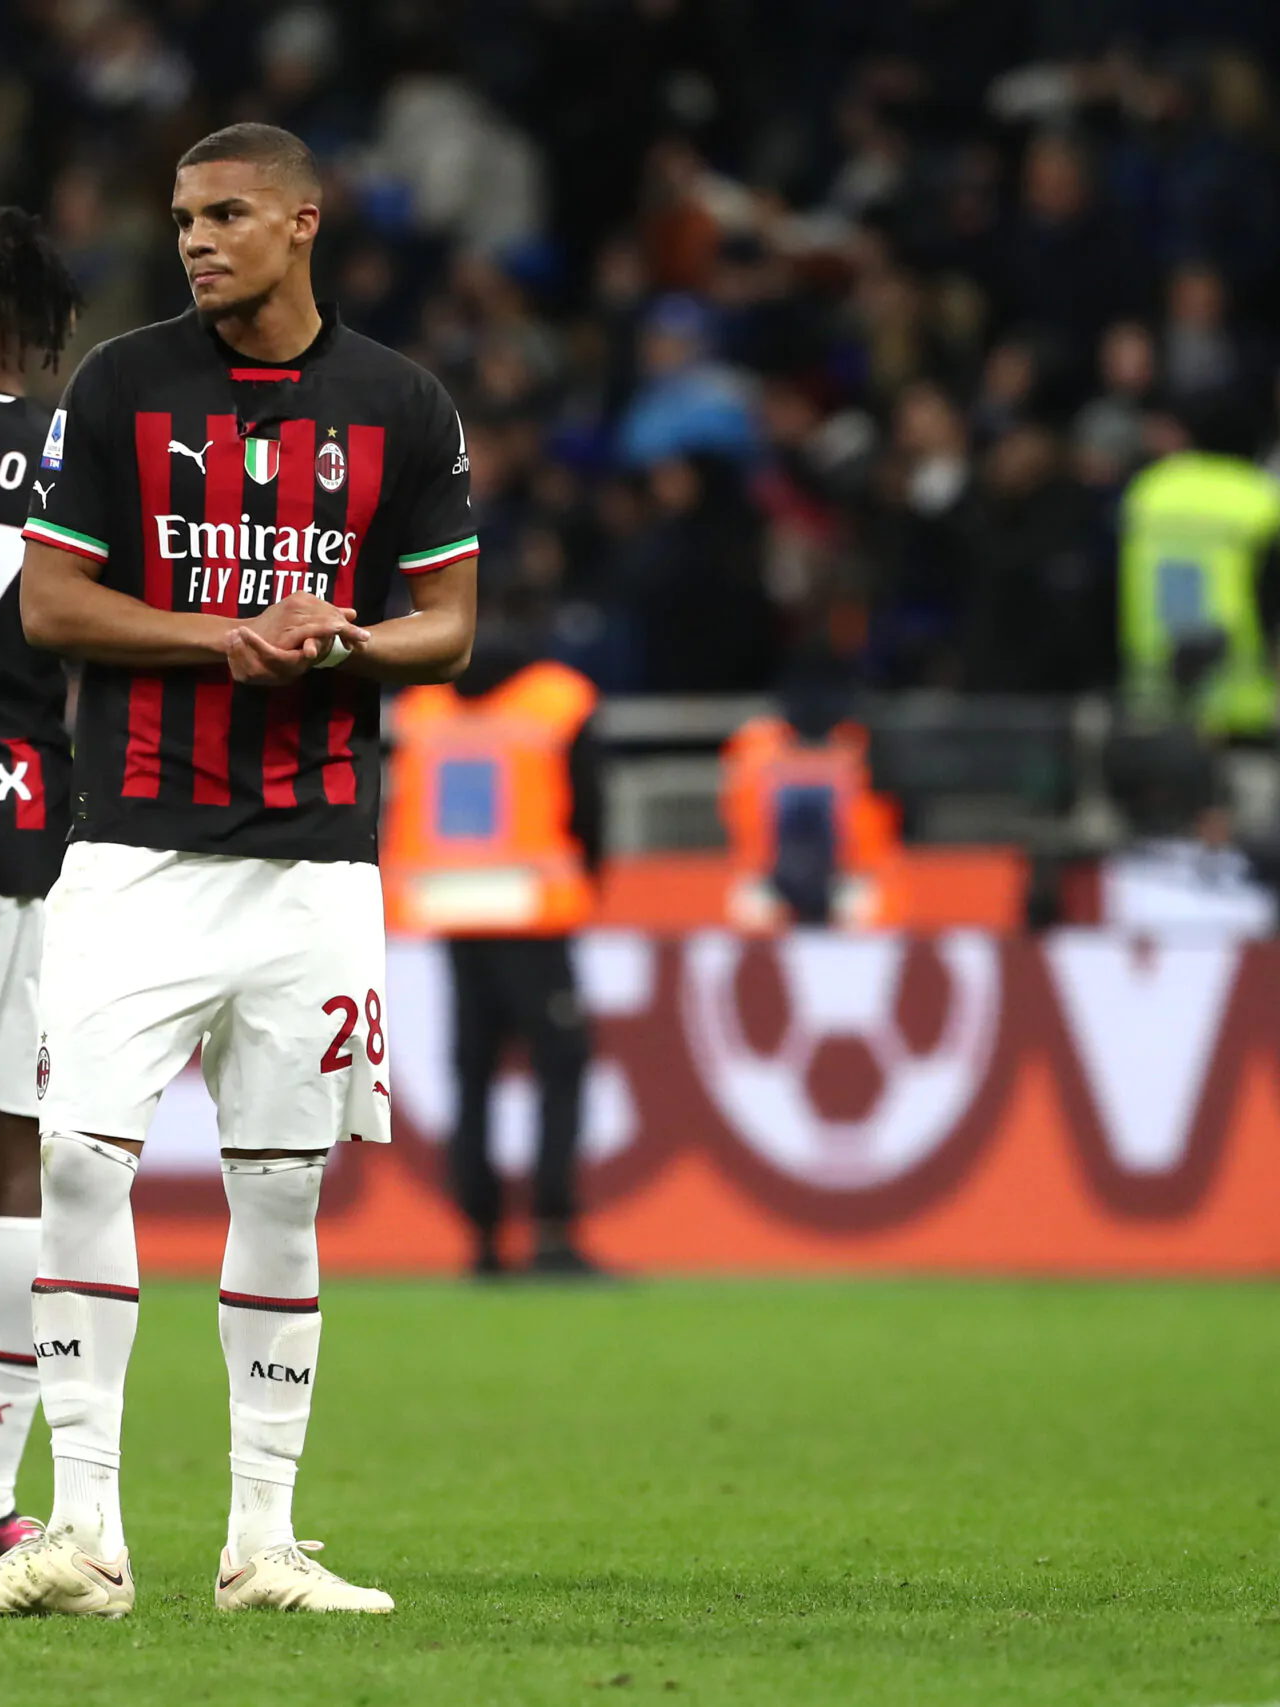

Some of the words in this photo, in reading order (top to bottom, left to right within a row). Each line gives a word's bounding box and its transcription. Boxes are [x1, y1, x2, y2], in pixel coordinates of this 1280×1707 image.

[154, 513, 357, 567] Emirates
[188, 566, 233, 604] FLY
[238, 568, 329, 605] BETTER
[321, 988, 385, 1074] 28
[251, 1360, 310, 1385] ACM
